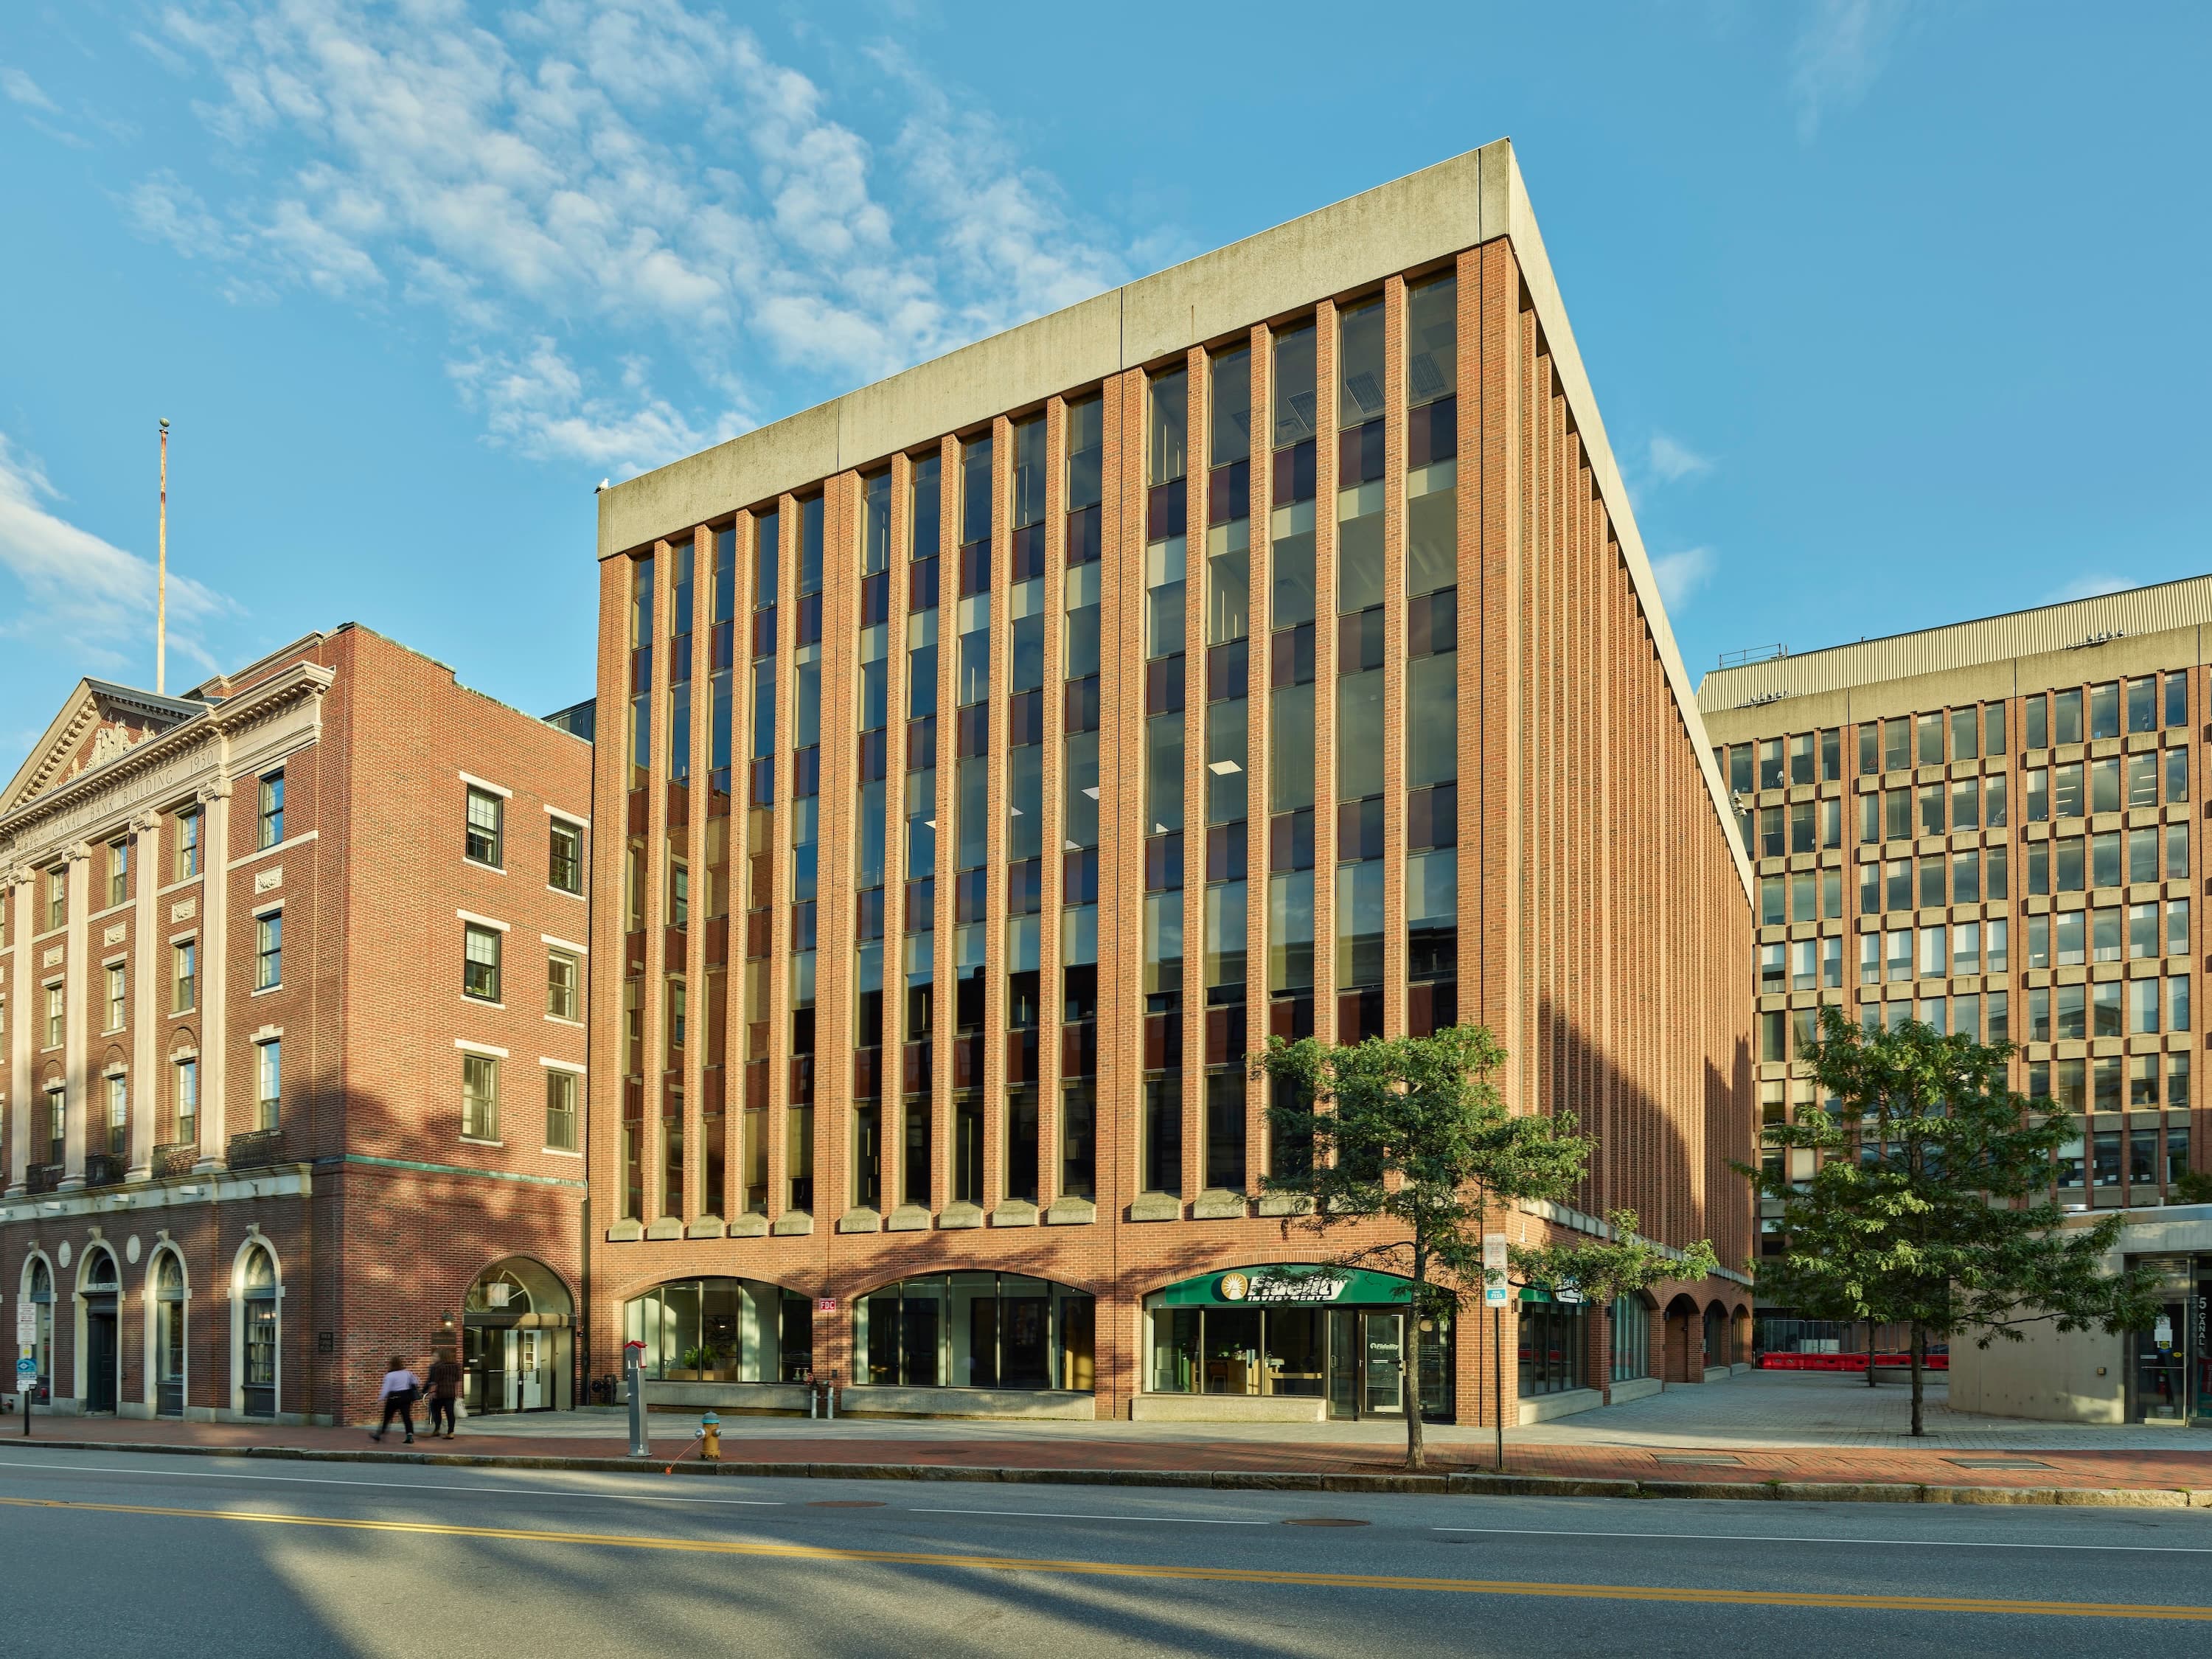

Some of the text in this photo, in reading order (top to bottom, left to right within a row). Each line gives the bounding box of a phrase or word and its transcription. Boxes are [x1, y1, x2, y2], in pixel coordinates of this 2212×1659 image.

[53, 813, 80, 836] CANAL
[90, 796, 114, 820] BANK
[123, 770, 173, 804] BUILDING
[190, 750, 212, 773] 1930
[820, 1301, 835, 1310] FDC
[2198, 1297, 2207, 1346] 5 CANAL
